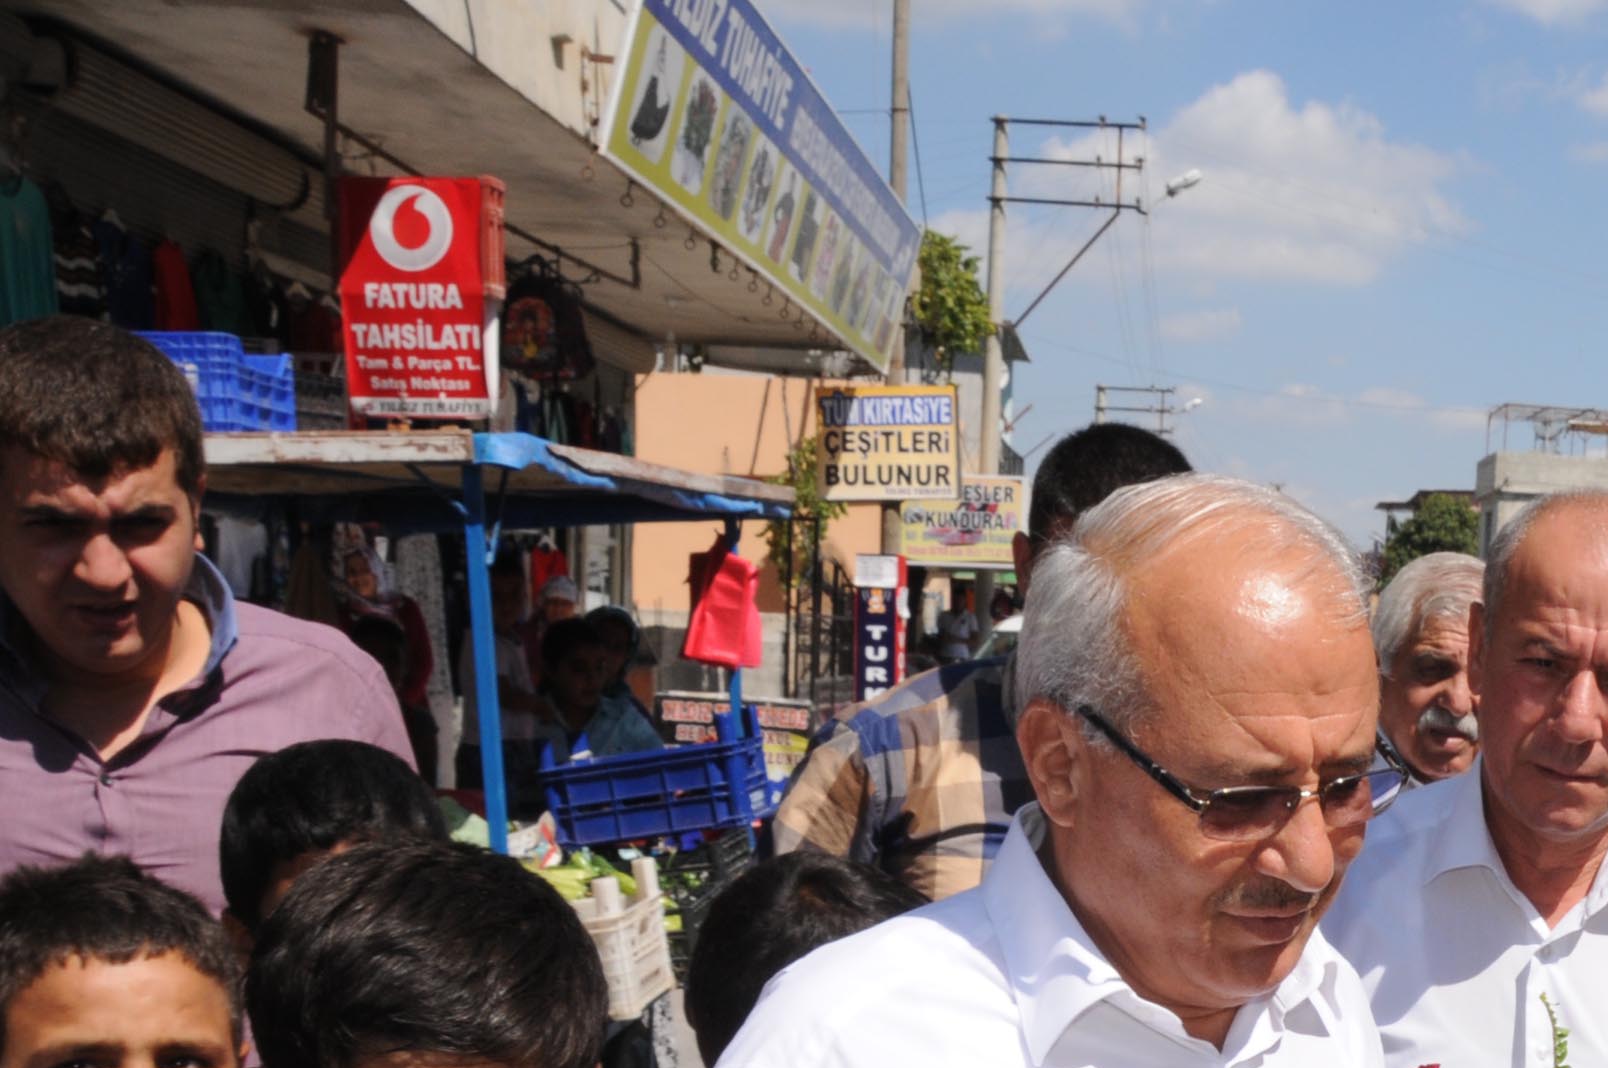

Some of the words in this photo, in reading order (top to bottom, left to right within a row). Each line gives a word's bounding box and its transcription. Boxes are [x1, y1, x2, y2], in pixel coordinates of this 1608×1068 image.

[364, 282, 463, 309] FATURA
[350, 318, 481, 350] TAHSİLATI
[356, 355, 388, 370] Tam
[392, 355, 404, 370] &
[408, 356, 452, 373] Parça
[822, 390, 861, 426] TÜM
[825, 464, 950, 486] BULUNUR
[963, 485, 1014, 502] ESLER
